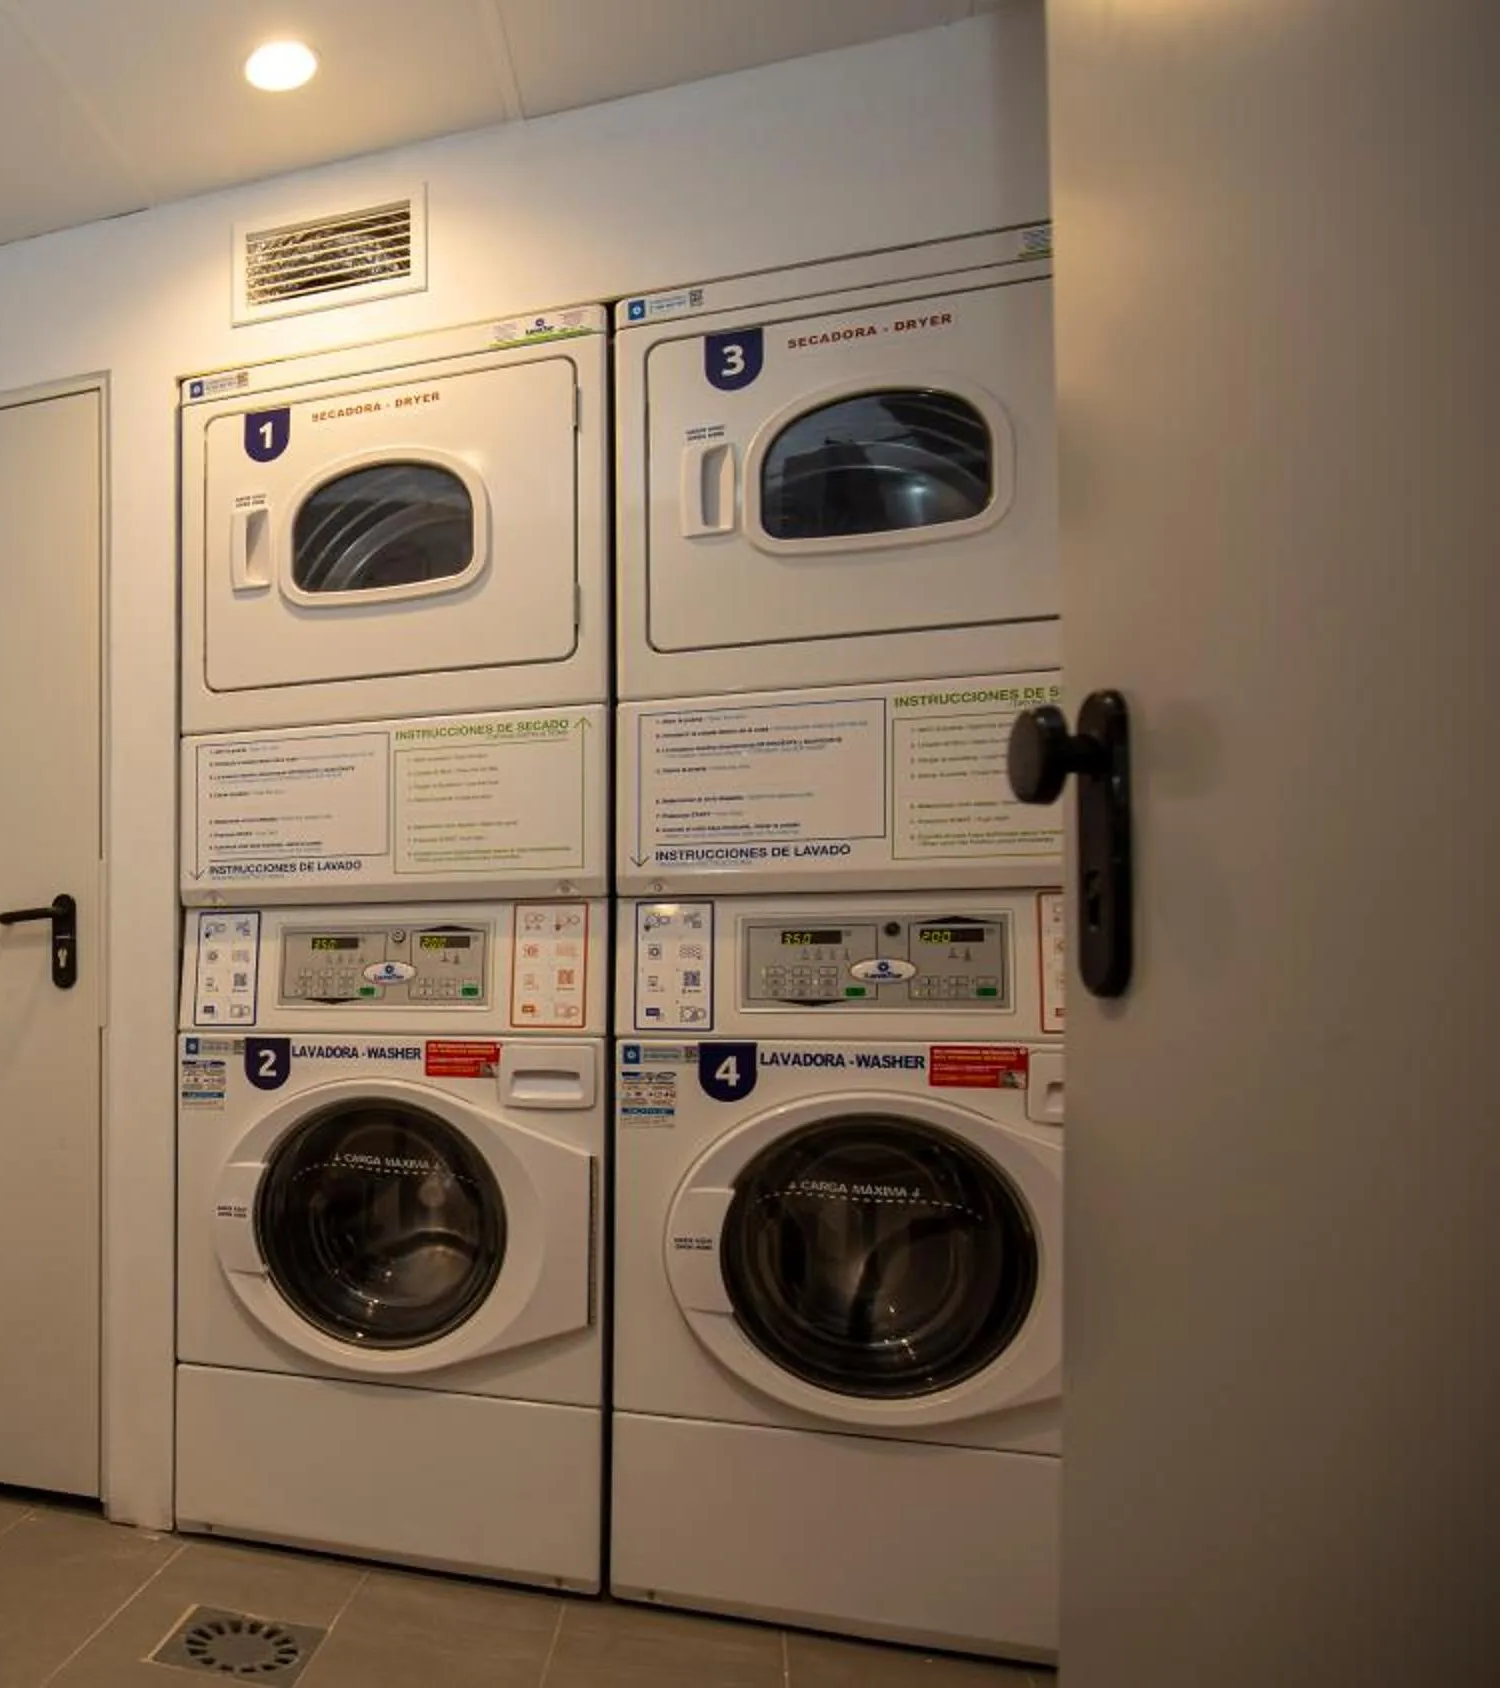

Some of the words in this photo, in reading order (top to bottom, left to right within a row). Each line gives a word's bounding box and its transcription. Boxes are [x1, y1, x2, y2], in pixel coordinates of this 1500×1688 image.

[787, 326, 877, 349] SECADORA
[894, 313, 953, 332] DRYER
[722, 344, 745, 377] 3
[311, 401, 382, 422] SECADORA
[395, 391, 440, 409] DRYER
[259, 420, 273, 449] 1
[894, 688, 1019, 707] INSTRUCCIONES
[1023, 687, 1045, 699] DE
[395, 723, 494, 741] INSTRUCCIONES
[499, 722, 513, 733] DE
[515, 719, 569, 732] SECADO
[655, 847, 767, 861] INSTRUCCIONES
[771, 846, 790, 858] DE
[794, 843, 851, 857] LAVADO
[209, 862, 297, 875] INSTRUCCIONES
[299, 861, 314, 872] DE
[317, 859, 362, 872] LAVADO
[258, 1049, 277, 1077] 2
[292, 1045, 359, 1059] LAVADORA
[367, 1046, 421, 1060] WASHER
[760, 1052, 845, 1067] LAVADORA
[855, 1054, 925, 1069] WASHER
[714, 1055, 741, 1087] 4
[800, 1180, 849, 1194] CARGA
